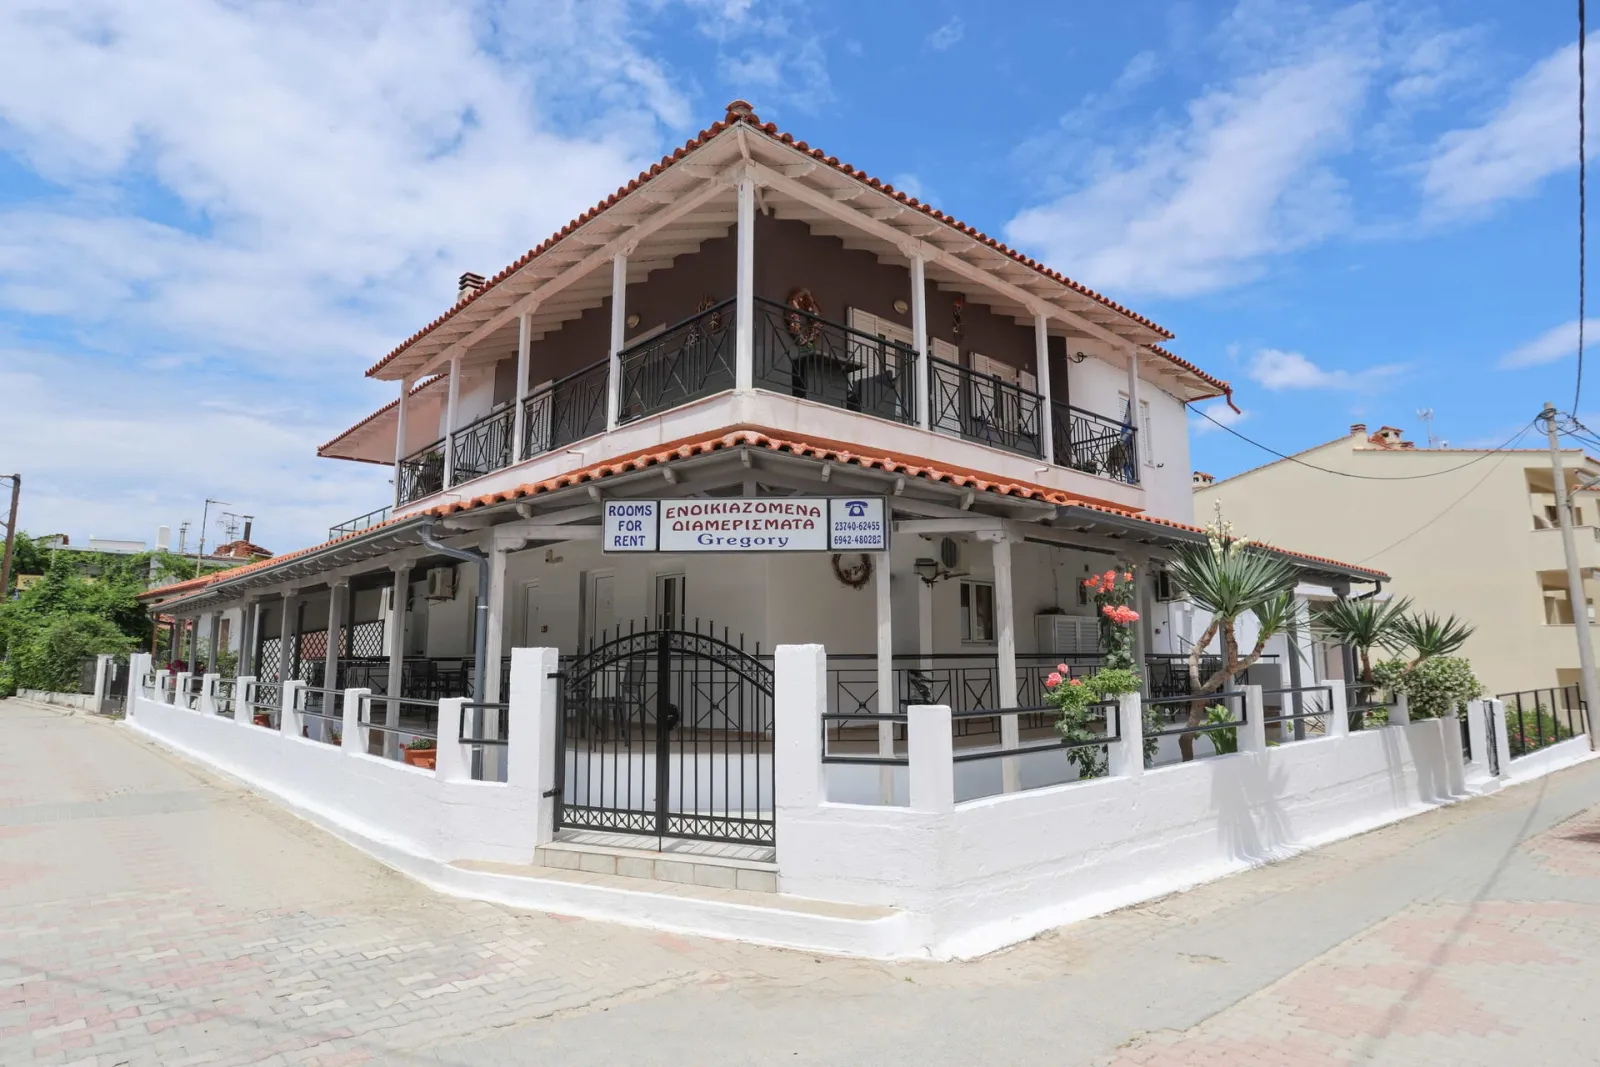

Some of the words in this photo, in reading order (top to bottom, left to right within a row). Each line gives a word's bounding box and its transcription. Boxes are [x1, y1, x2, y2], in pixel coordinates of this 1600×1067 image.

[608, 505, 653, 517] ROOMS
[665, 502, 821, 519] ΕΝΟΙΚΙΑΖΟΜΕΝΑ
[618, 520, 642, 531] FOR
[672, 519, 815, 532] ΔΙΑΜΕΡΙΣΜΑΤΑ
[834, 521, 880, 532] 23740-62455
[614, 535, 646, 547] RENT
[697, 533, 789, 548] Gregory
